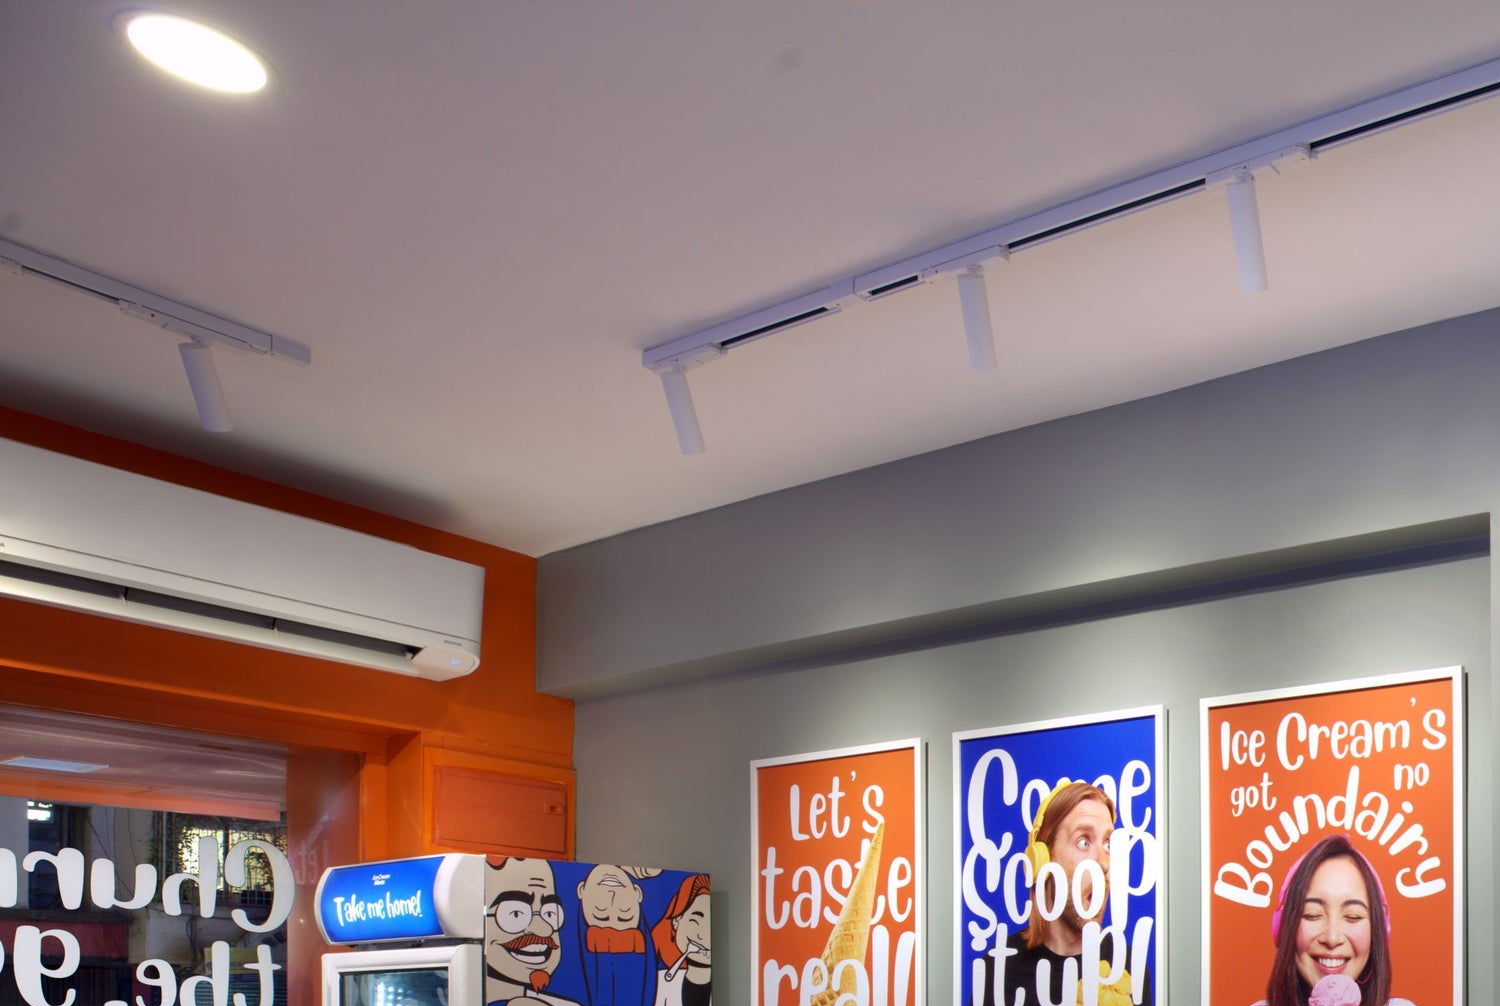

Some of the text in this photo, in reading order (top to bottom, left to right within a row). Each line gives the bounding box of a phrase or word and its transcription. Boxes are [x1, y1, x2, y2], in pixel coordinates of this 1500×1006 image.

[1220, 697, 1447, 771] Ice Cream's
[789, 770, 885, 841] Let's
[968, 749, 1152, 860] Coe
[1230, 763, 1430, 817] got no
[1214, 765, 1447, 908] Boundairy
[333, 889, 424, 927] Take me home!
[962, 828, 1156, 939] Scoop
